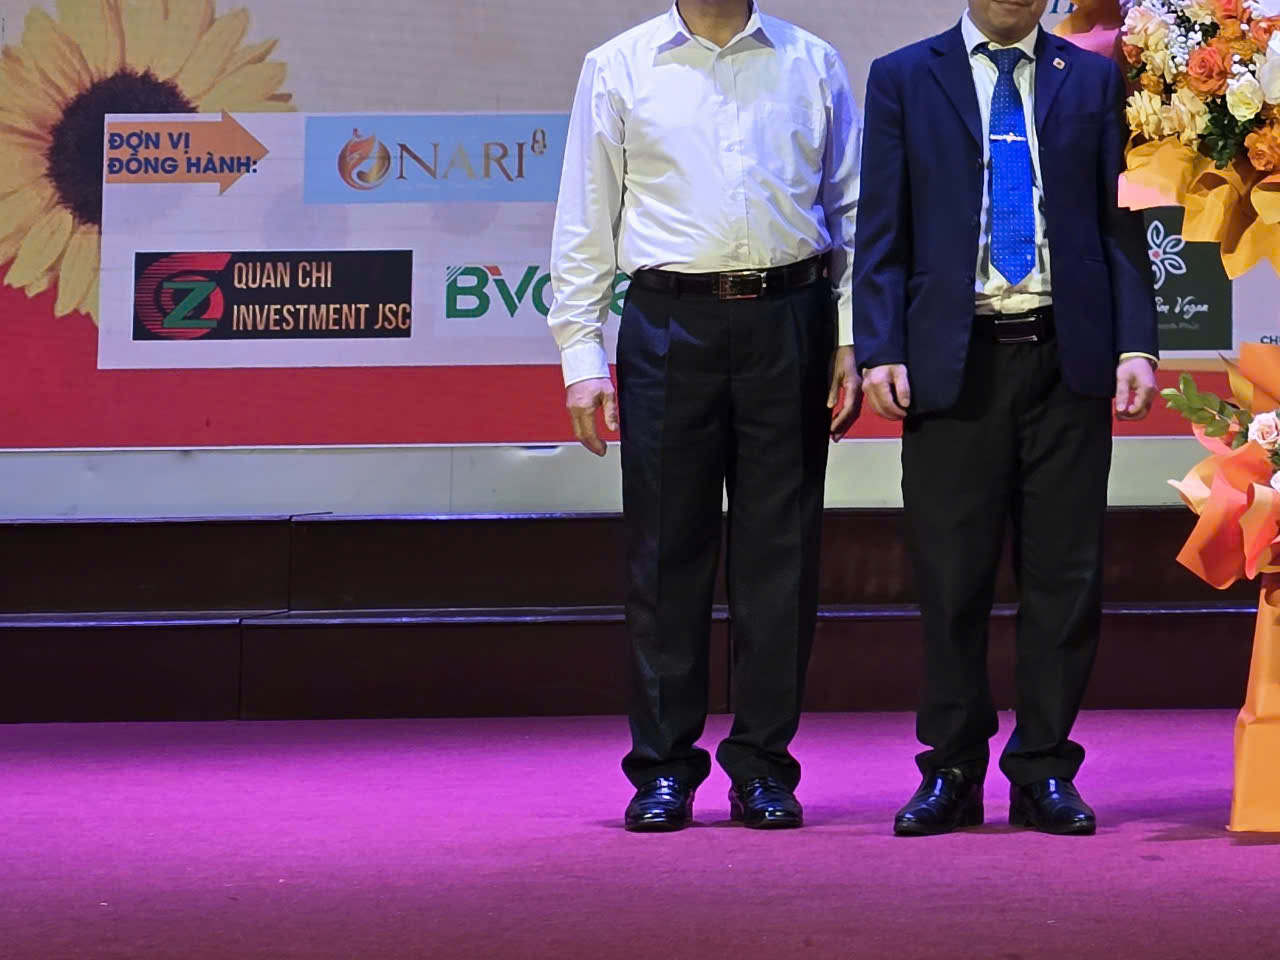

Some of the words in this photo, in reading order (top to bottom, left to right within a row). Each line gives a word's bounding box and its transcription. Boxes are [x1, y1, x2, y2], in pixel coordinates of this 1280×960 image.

[167, 131, 190, 155] VỊ
[186, 151, 258, 174] HÀNH:
[233, 261, 291, 290] QUAN
[298, 261, 333, 289] CHI
[232, 303, 370, 331] INVESTMENT
[374, 302, 412, 330] JSC
